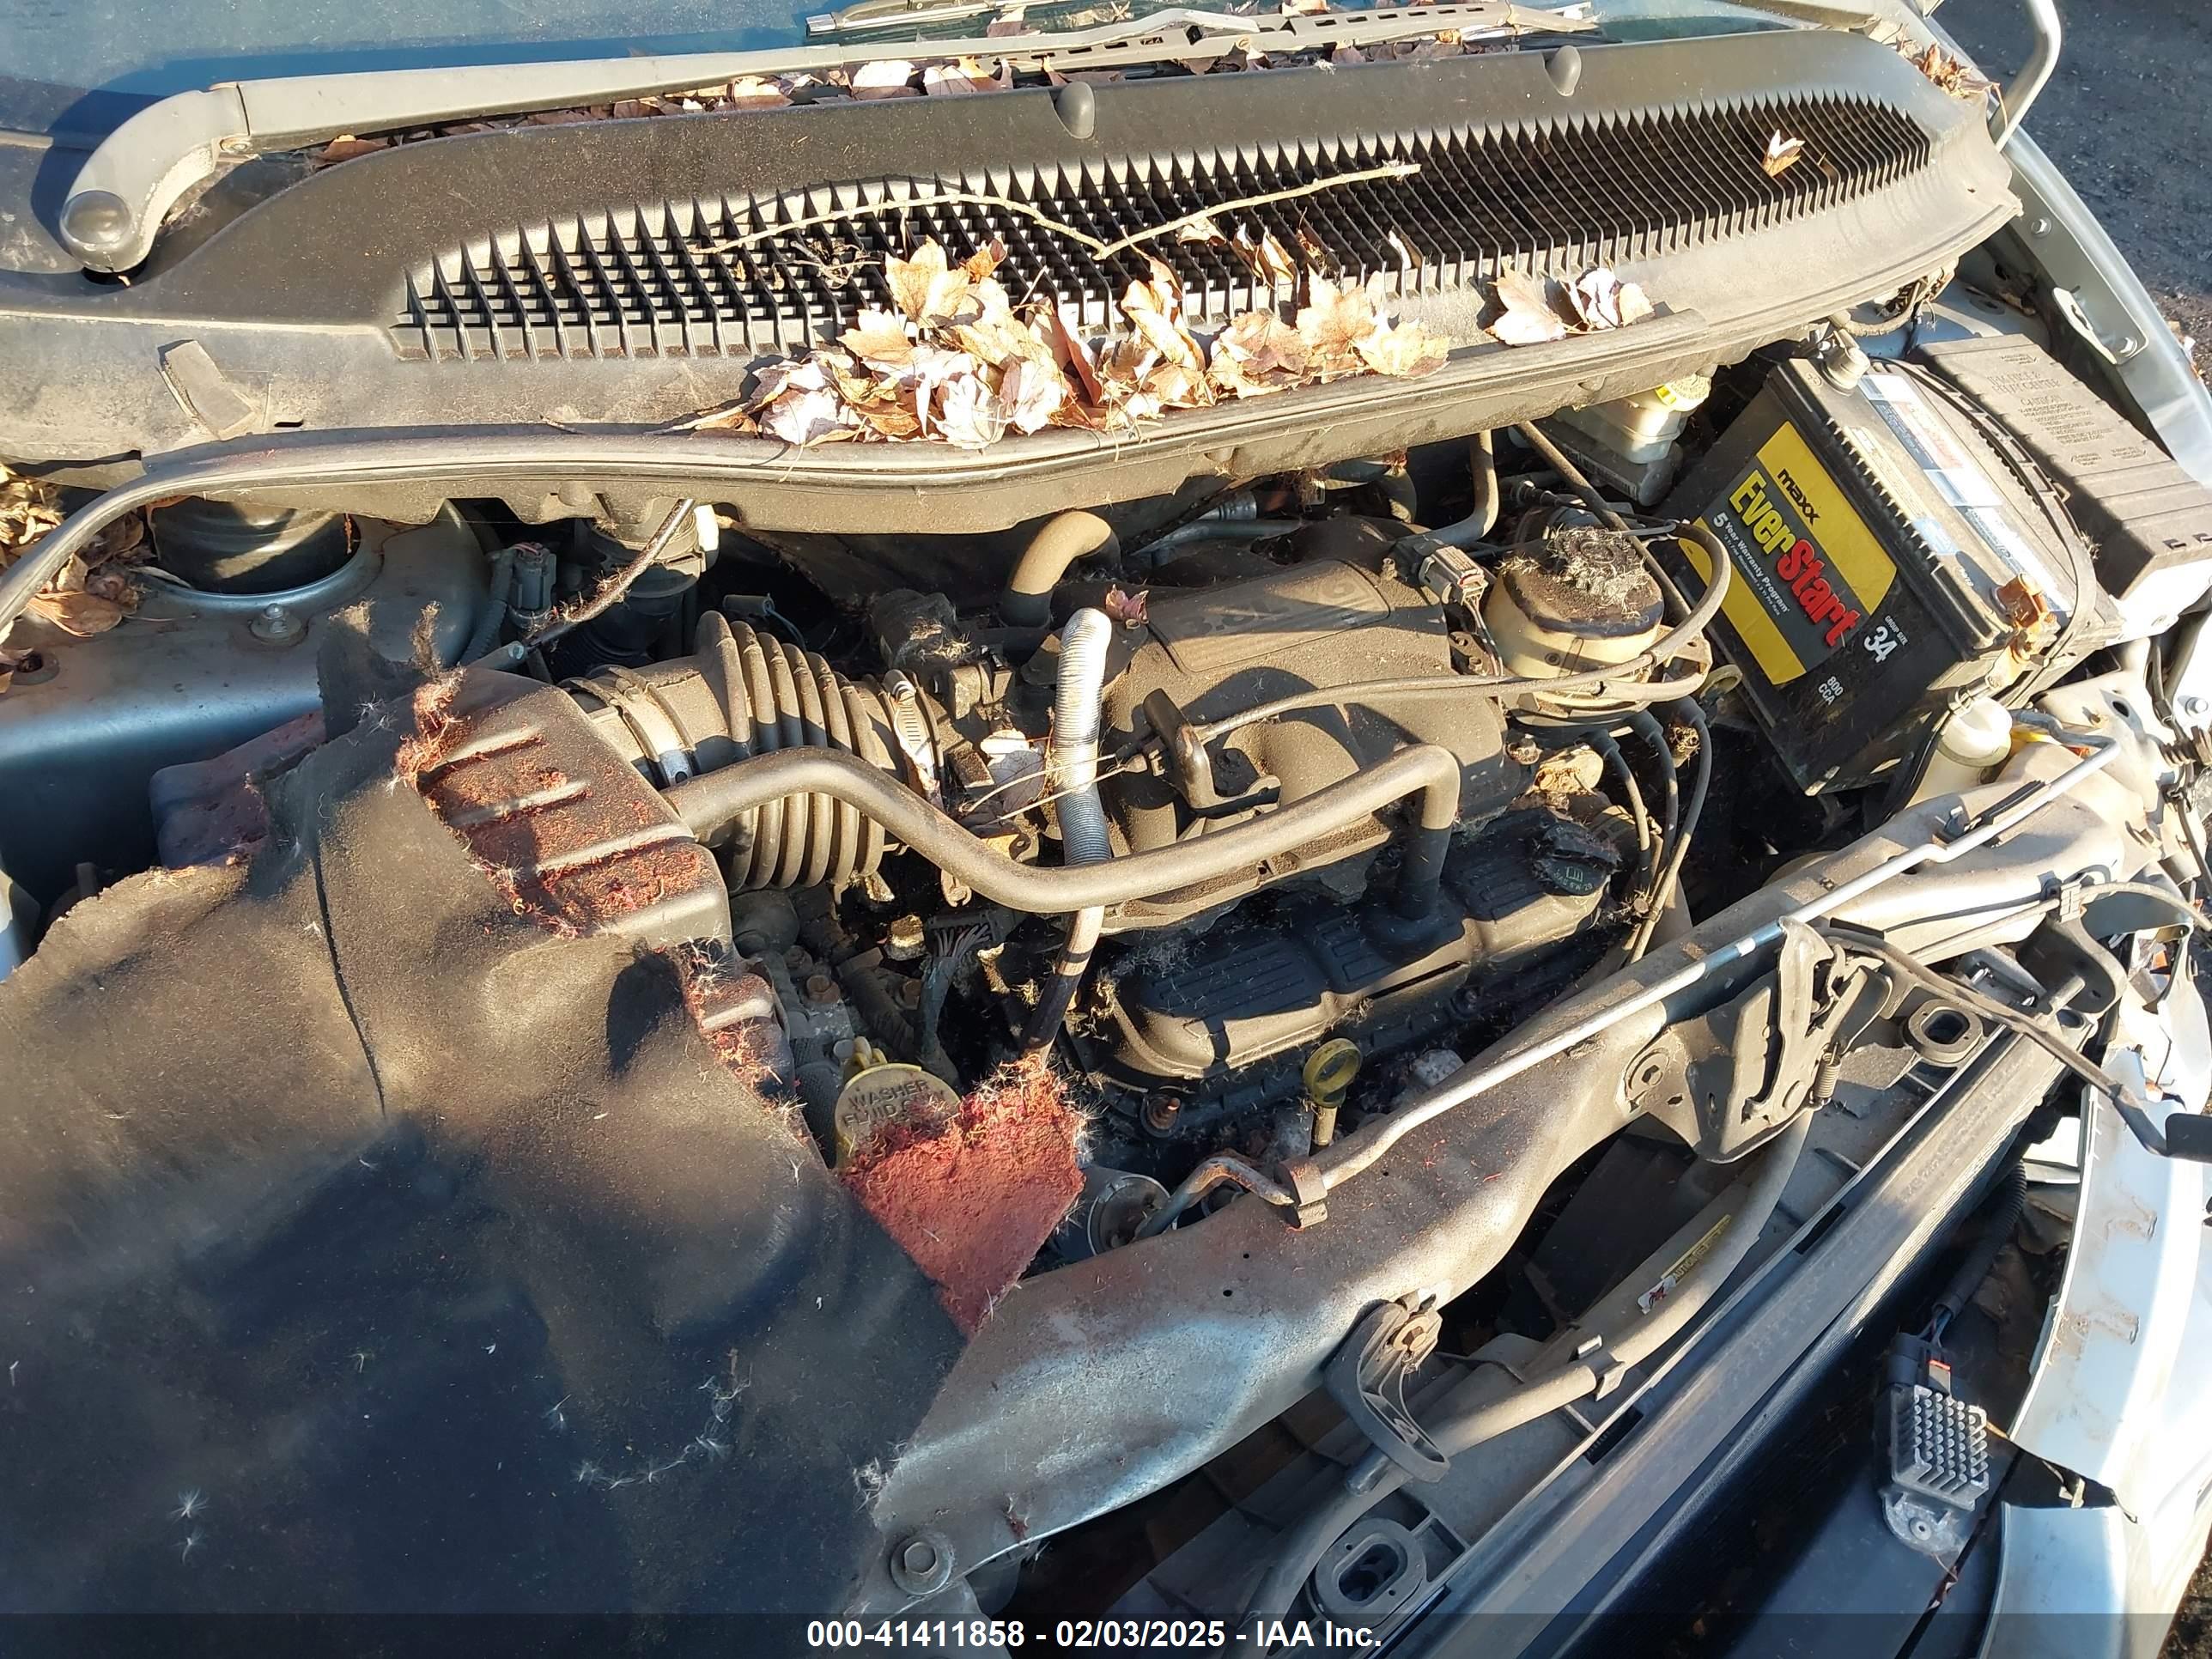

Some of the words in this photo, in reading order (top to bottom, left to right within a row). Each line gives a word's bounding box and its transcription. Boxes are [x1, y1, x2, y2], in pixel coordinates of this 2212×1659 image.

[1778, 469, 1820, 526] maxx
[1712, 512, 1729, 528] 5
[1725, 521, 1740, 544] Year
[1737, 539, 1765, 578] Warranty
[1729, 470, 1861, 647] EverStart
[1863, 625, 1898, 663] 34
[1884, 615, 1899, 634] GROUP
[1896, 631, 1908, 646] SIZE
[1818, 683, 1836, 706] CCA
[1826, 676, 1844, 696] 800
[848, 1079, 928, 1109] WASHER
[842, 1103, 899, 1127] FLUID
